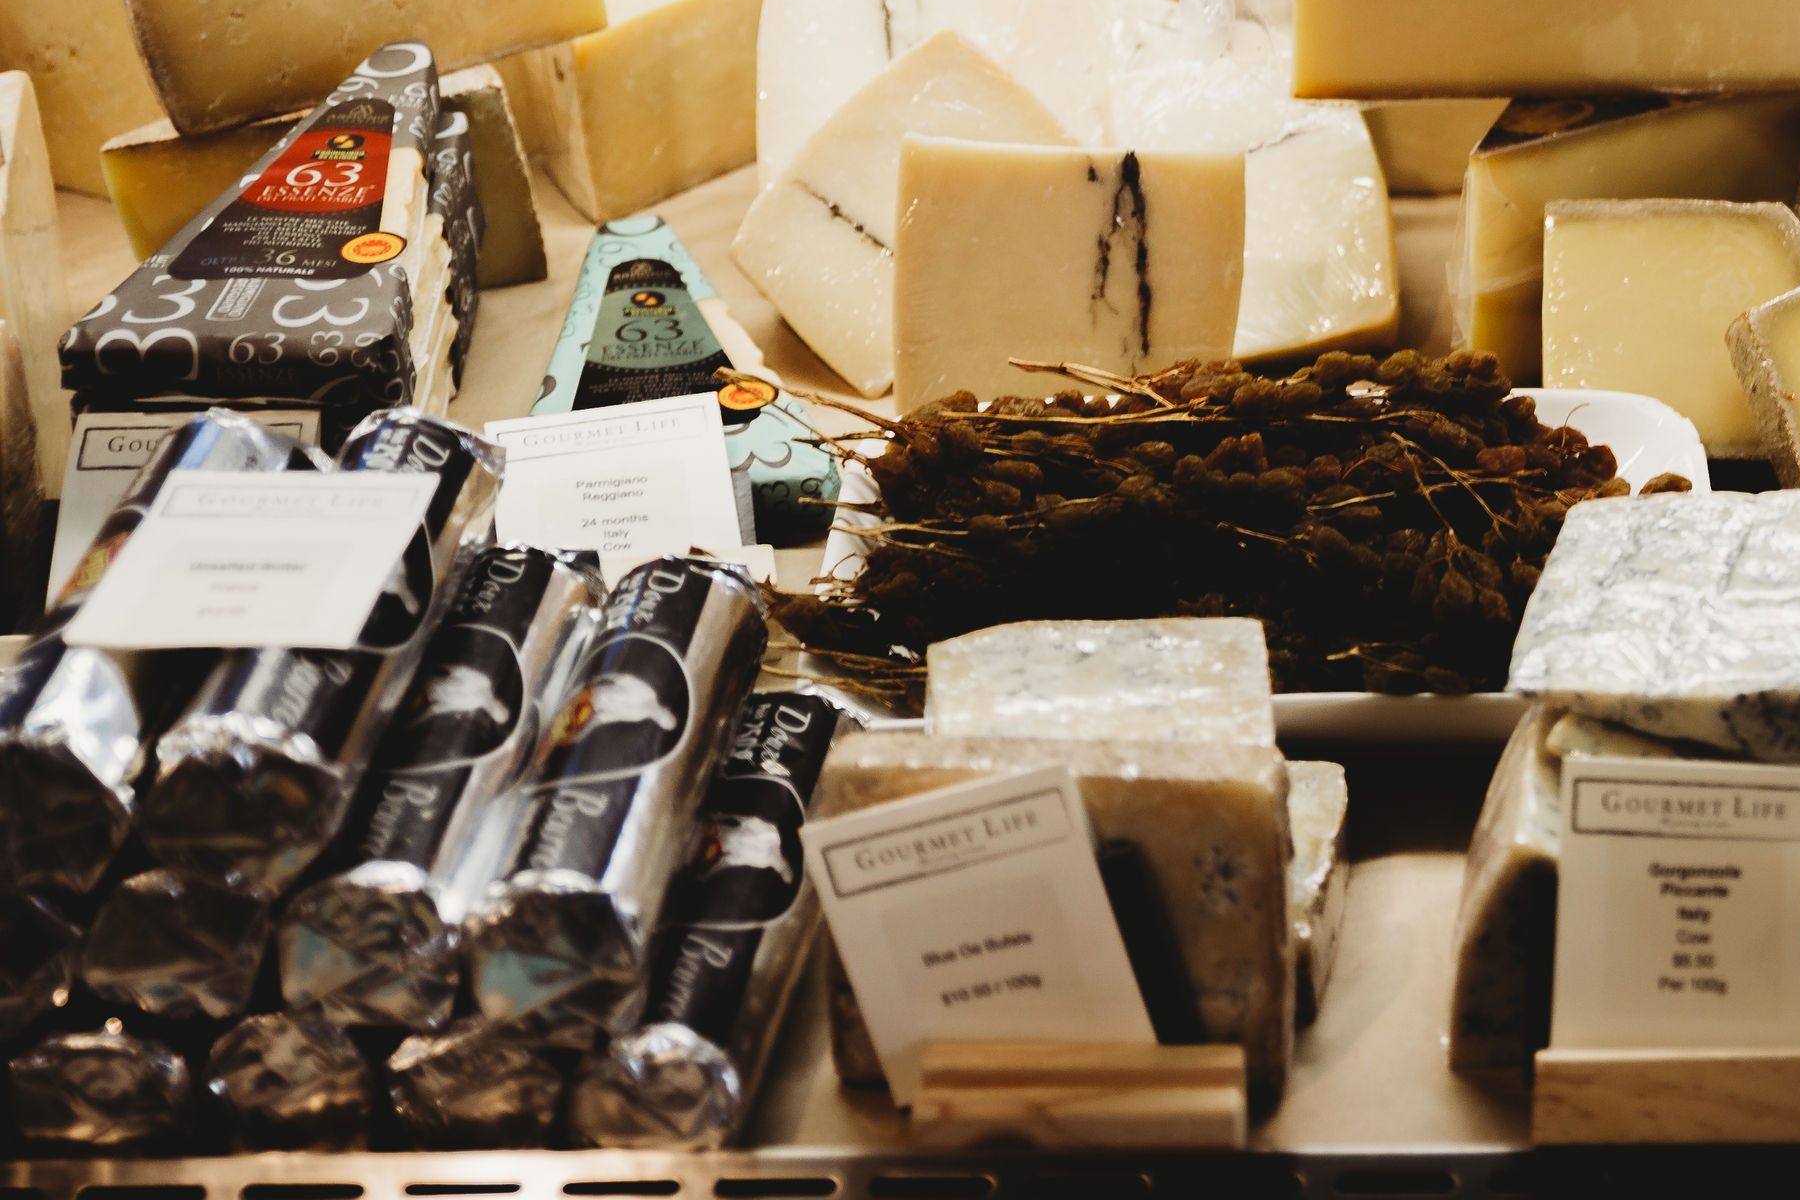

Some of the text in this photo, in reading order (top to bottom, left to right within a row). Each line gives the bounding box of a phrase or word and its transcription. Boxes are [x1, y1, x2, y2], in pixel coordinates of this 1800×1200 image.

[286, 161, 364, 187] 63
[261, 186, 368, 197] ESSENZE
[256, 267, 316, 276] NATURALE
[615, 319, 684, 343] 63
[228, 332, 287, 365] 63
[107, 435, 168, 454] GOU
[576, 475, 648, 490] Parmigiano
[582, 488, 644, 503] Reggiano
[581, 514, 648, 528] 24 months
[603, 528, 630, 541] Italy
[602, 542, 632, 553] Cow
